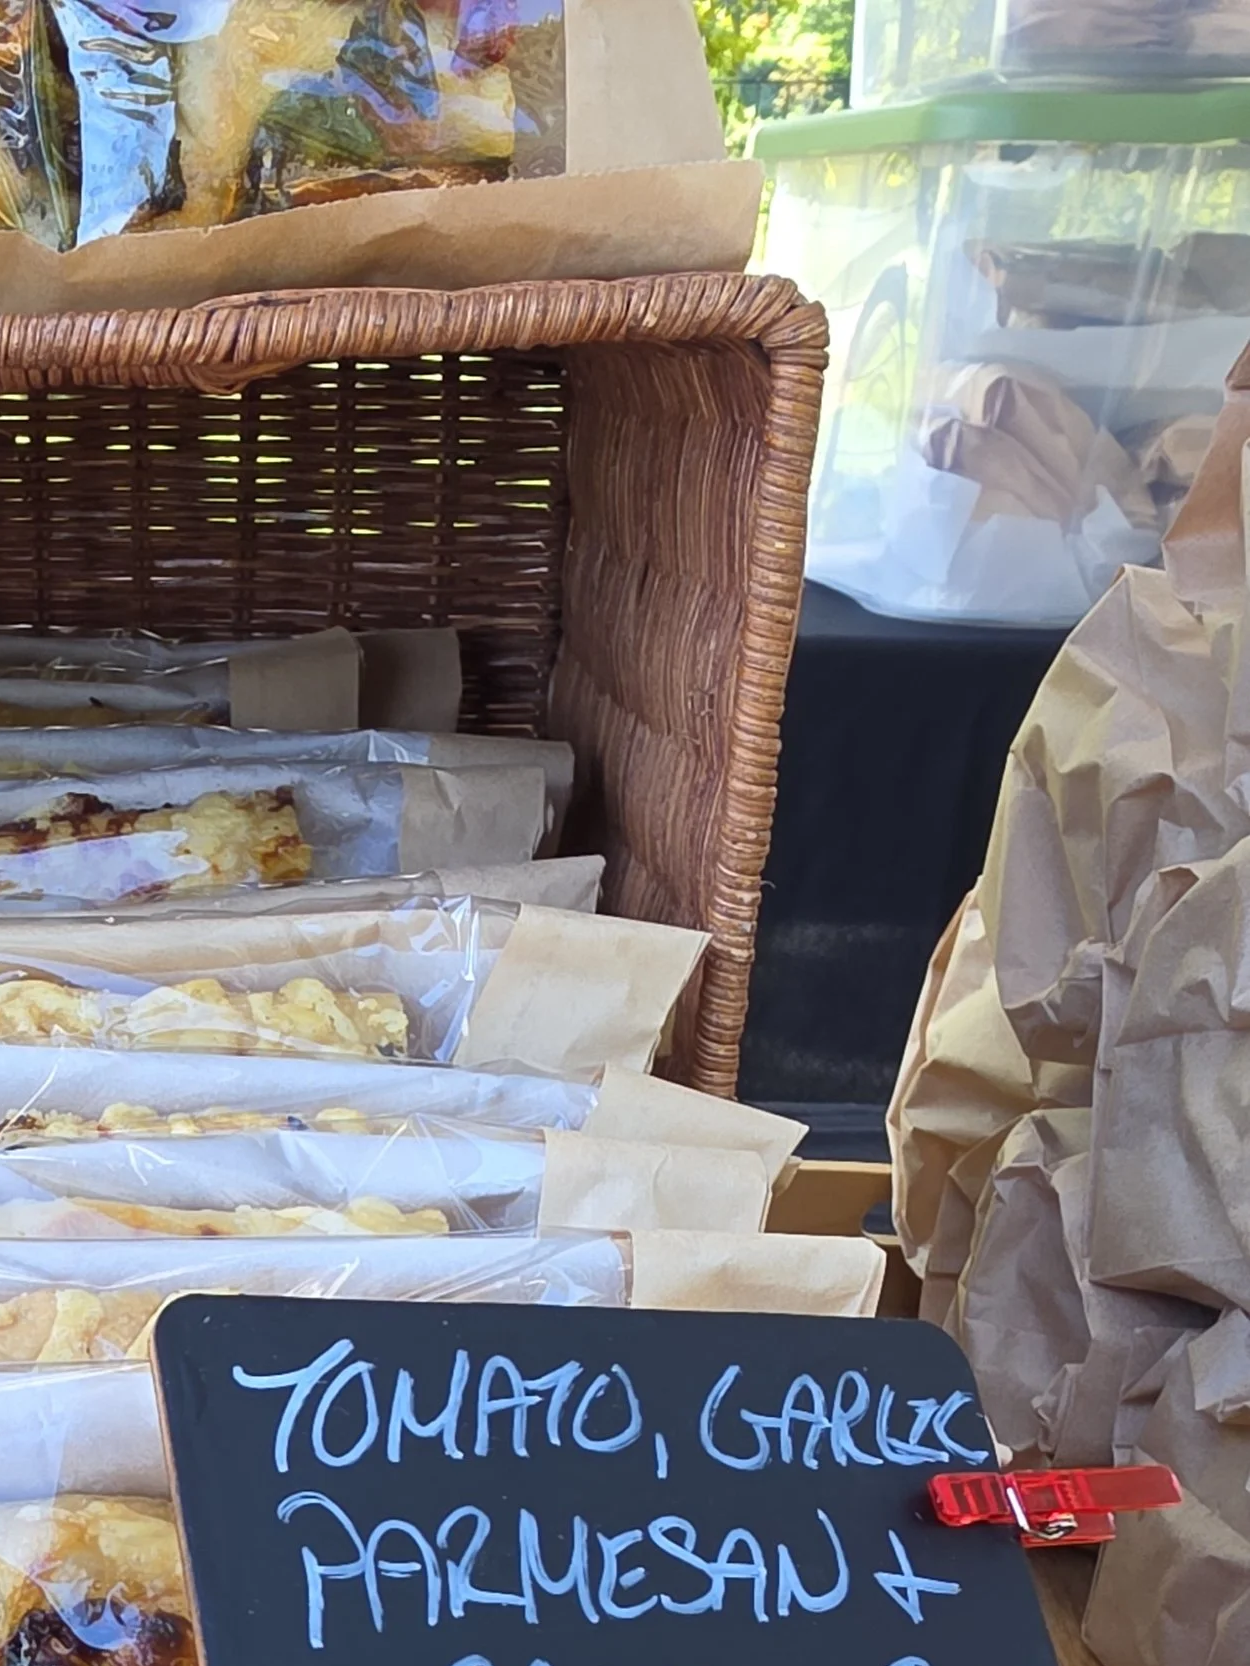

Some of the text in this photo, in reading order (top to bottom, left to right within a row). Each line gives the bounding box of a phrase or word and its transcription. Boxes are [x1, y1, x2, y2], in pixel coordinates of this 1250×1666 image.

[232, 1338, 990, 1479] TOMATO, GARLIC
[276, 1490, 962, 1649] PARMESAN +
